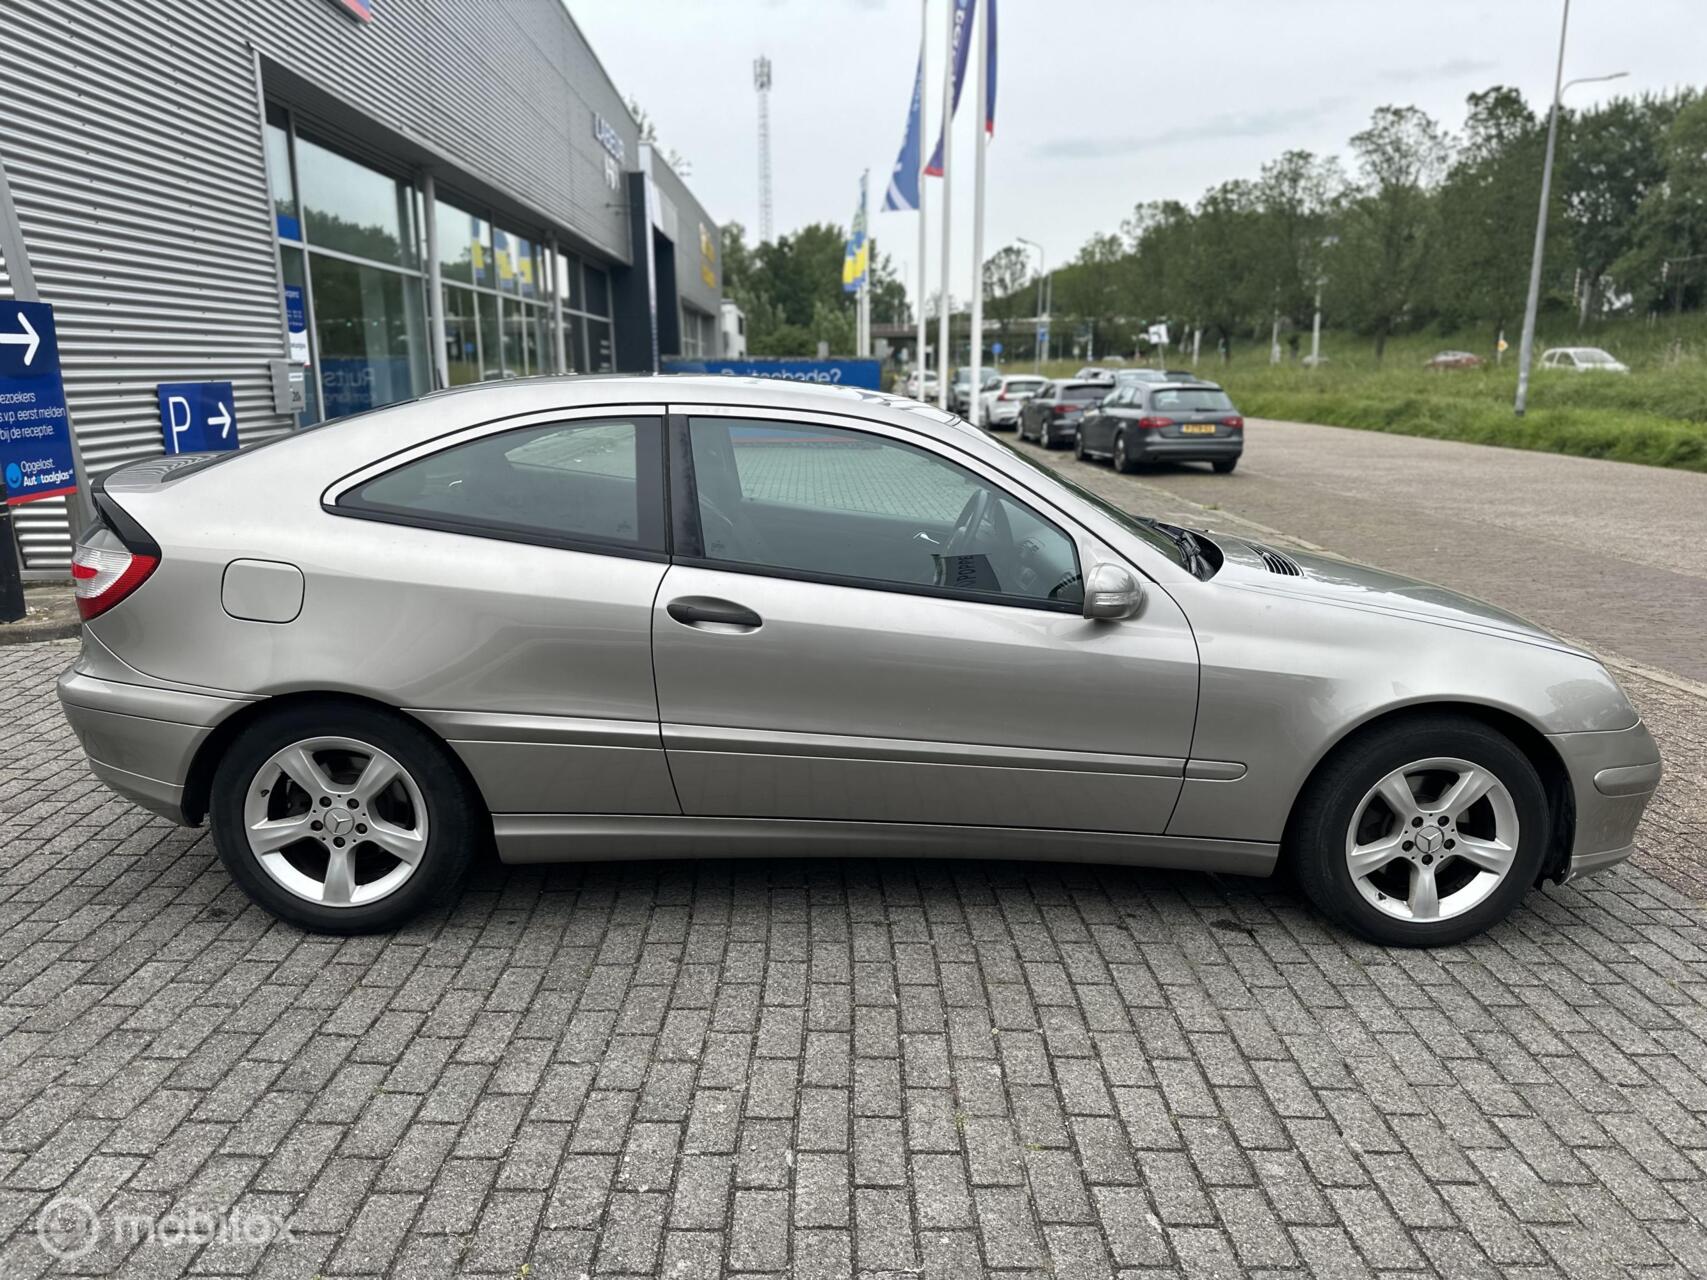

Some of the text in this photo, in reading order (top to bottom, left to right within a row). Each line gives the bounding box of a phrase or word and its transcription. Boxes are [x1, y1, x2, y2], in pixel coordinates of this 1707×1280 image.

[17, 409, 38, 421] eerst
[39, 406, 66, 420] melden
[10, 426, 21, 439] de
[168, 396, 192, 454] P
